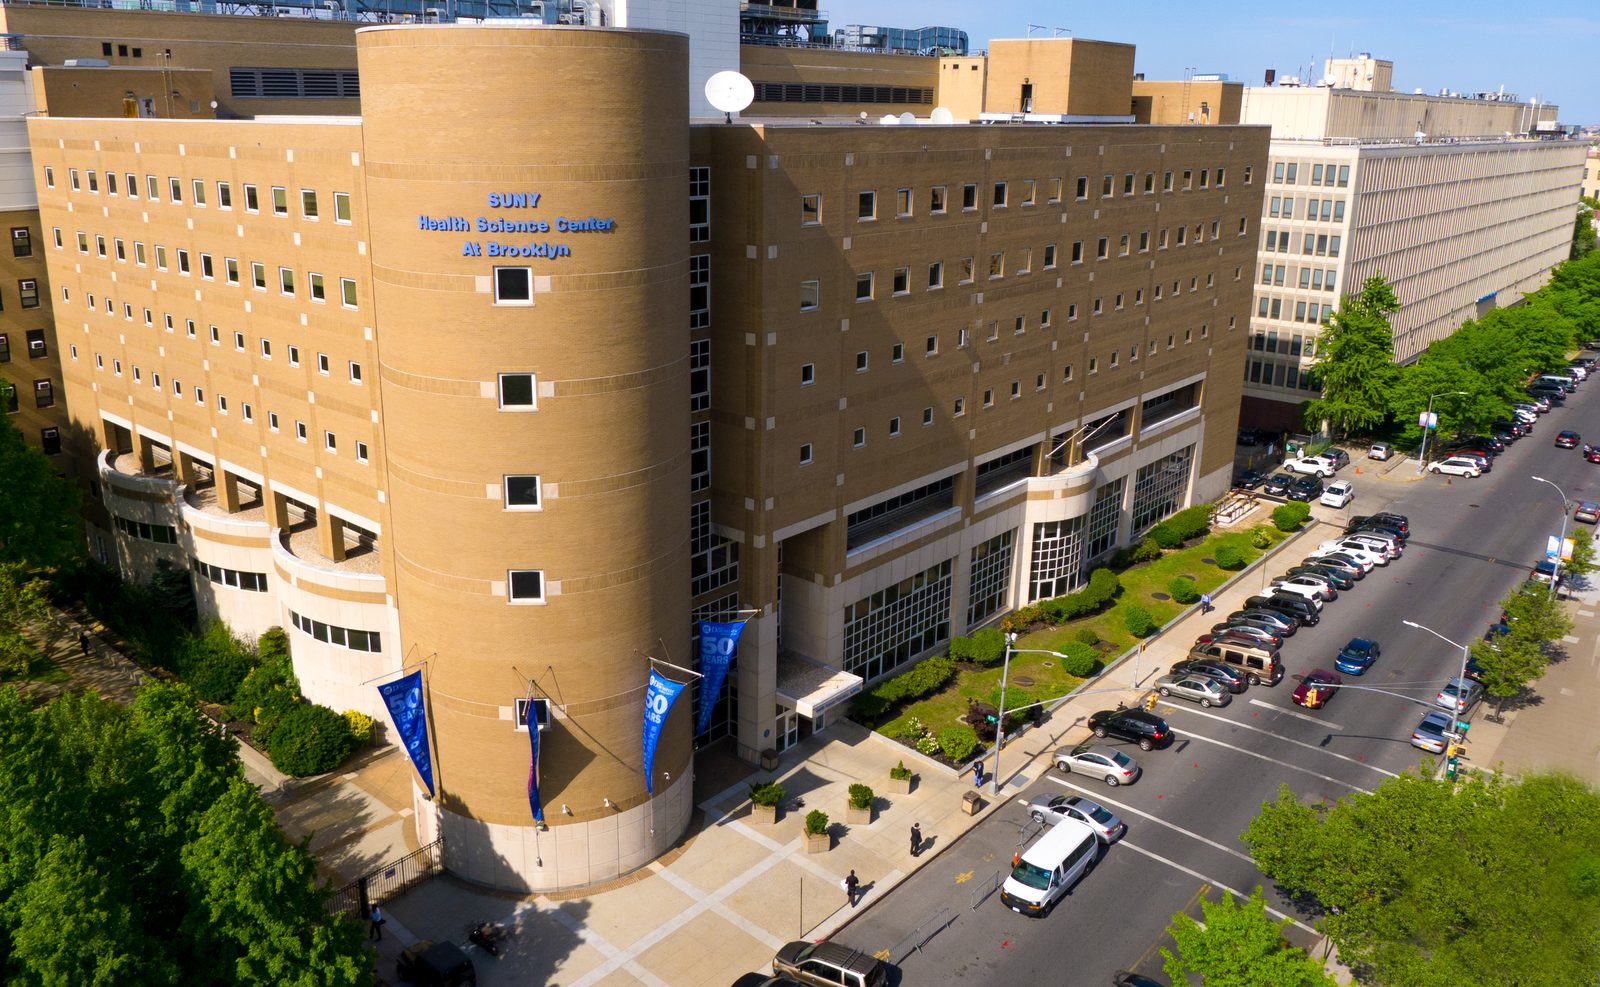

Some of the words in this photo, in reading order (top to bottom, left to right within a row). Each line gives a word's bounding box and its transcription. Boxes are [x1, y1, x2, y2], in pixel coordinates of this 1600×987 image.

[487, 192, 540, 207] SUNY
[418, 215, 469, 232] Health
[475, 216, 549, 233] Science
[555, 216, 614, 232] Center
[462, 242, 481, 257] At
[487, 242, 570, 260] Brooklyn
[702, 636, 734, 655] 50
[702, 655, 729, 665] YEARS
[389, 687, 421, 714] 50
[645, 687, 668, 715] 50
[395, 706, 424, 724] YEARS
[645, 708, 662, 724] EARS
